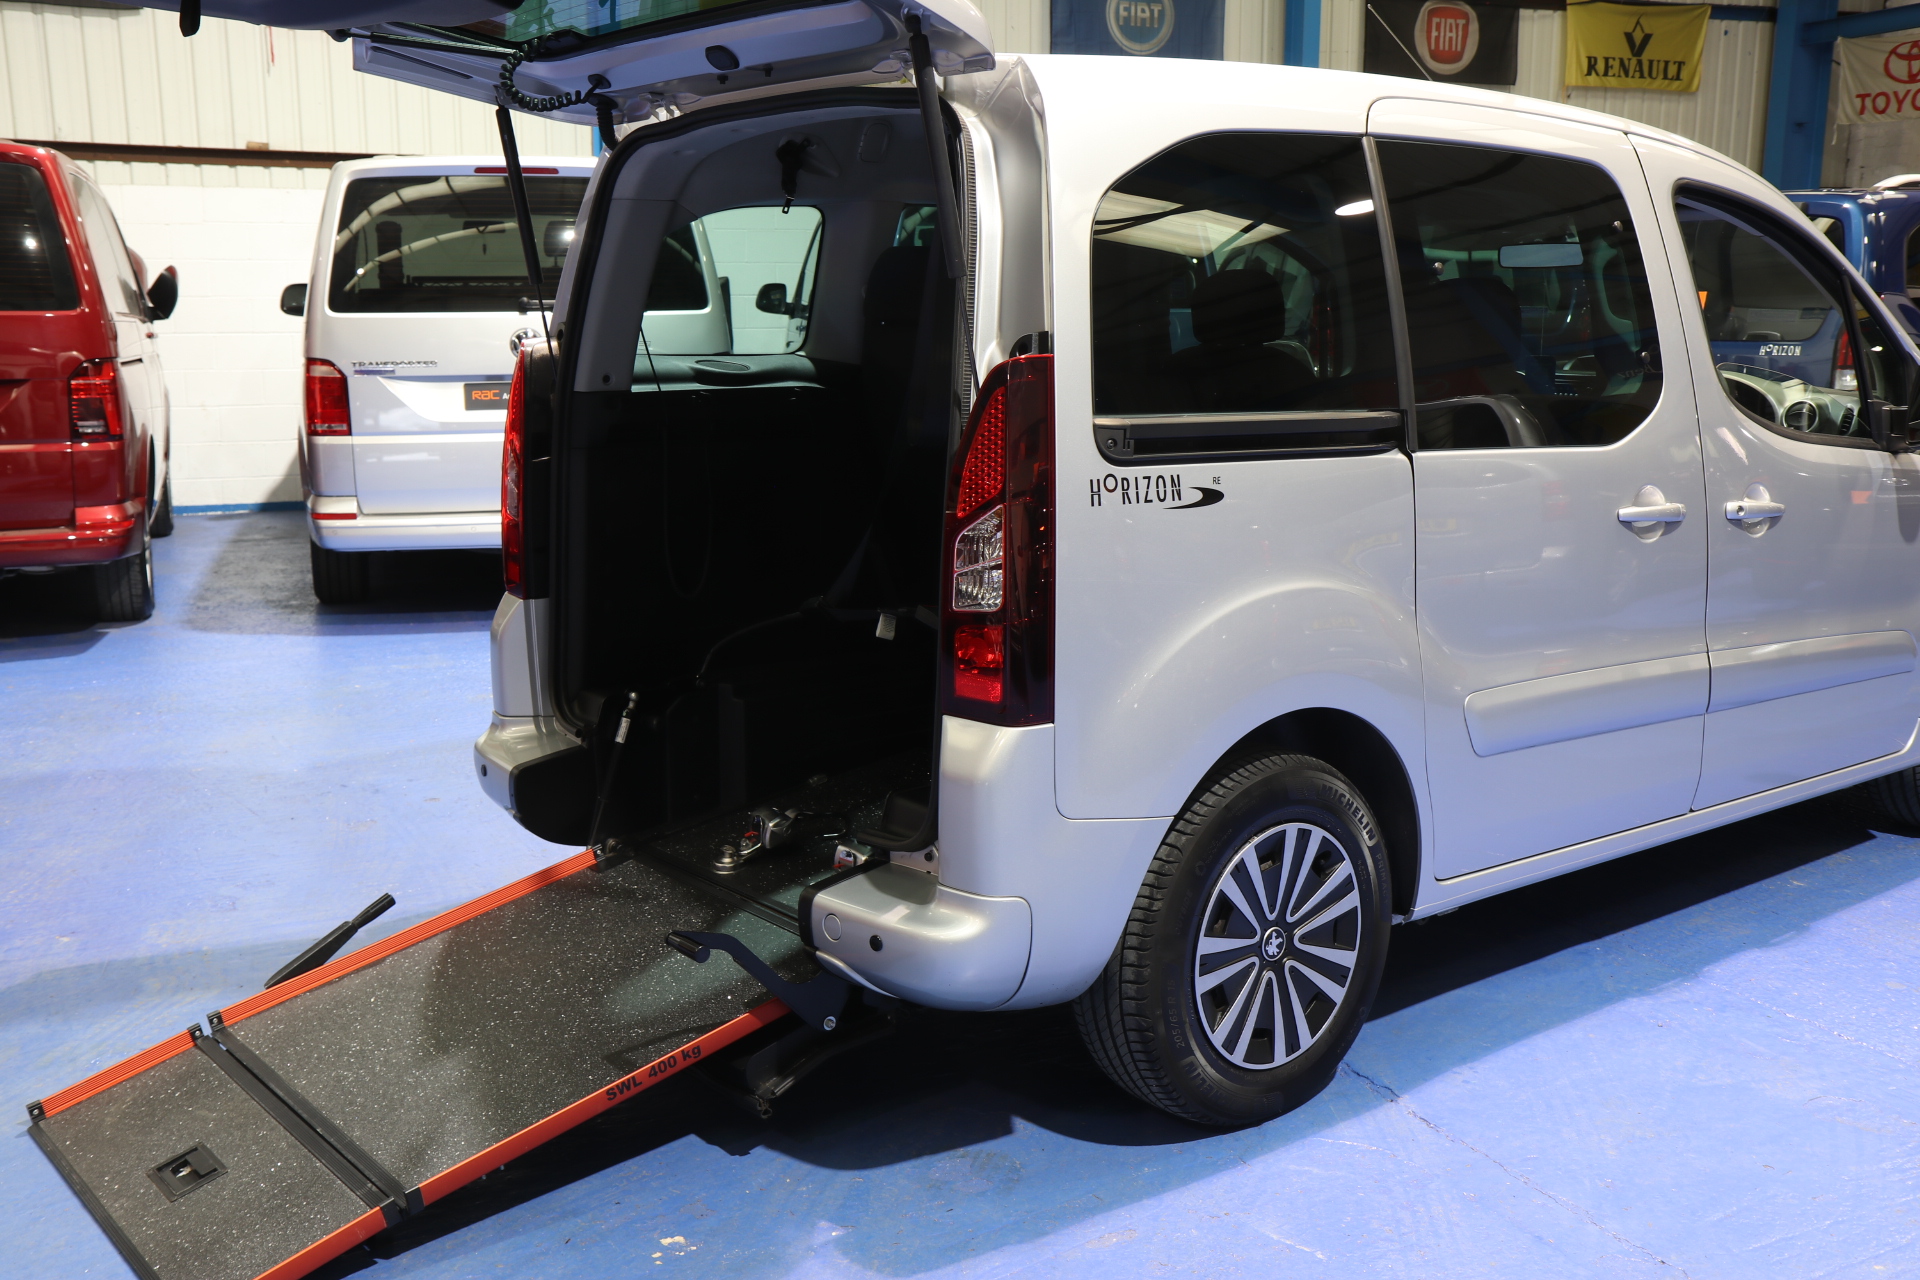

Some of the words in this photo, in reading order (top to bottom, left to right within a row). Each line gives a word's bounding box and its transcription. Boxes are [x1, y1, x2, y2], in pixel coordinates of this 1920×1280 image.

[1119, 3, 1162, 28] FIAT
[1431, 17, 1466, 51] FIAT
[1584, 55, 1686, 82] RENAULT
[1759, 344, 1802, 356] HORIZON
[1089, 473, 1182, 507] HORIZON
[1212, 476, 1222, 485] RE
[1320, 783, 1376, 842] MICHELIN
[606, 1076, 643, 1101] SWL
[648, 1055, 677, 1078] 400
[681, 1045, 702, 1061] kg
